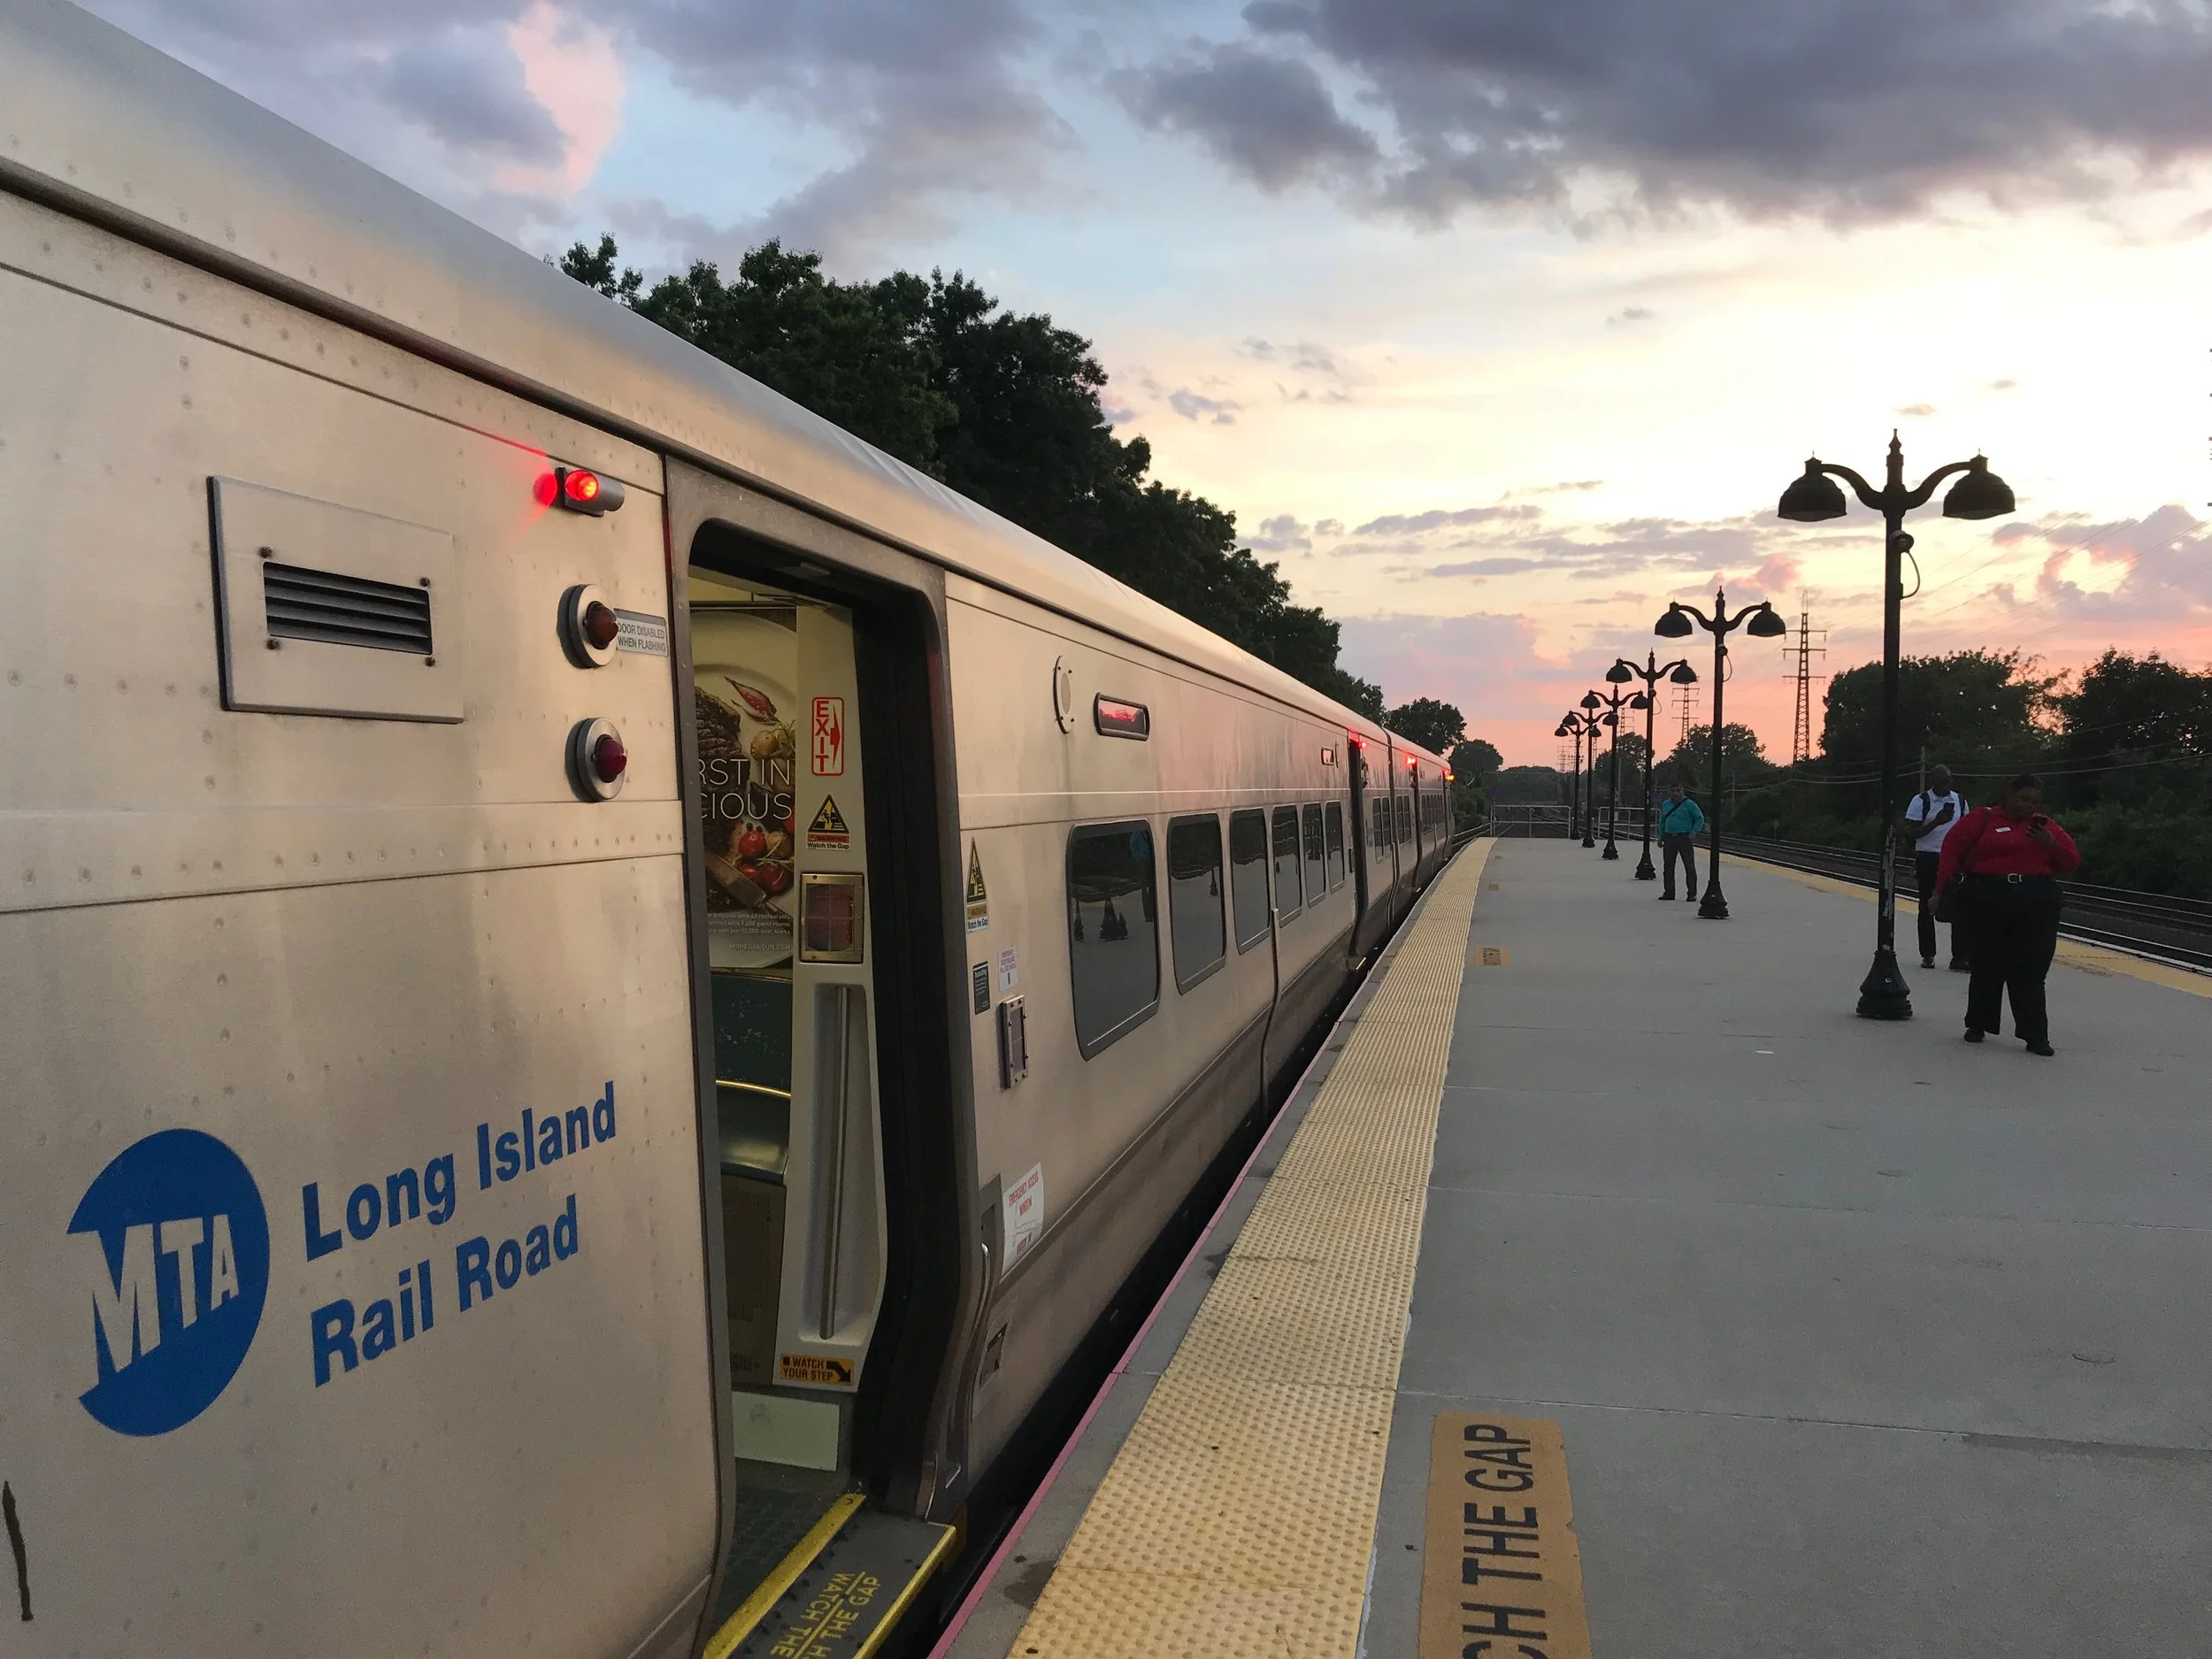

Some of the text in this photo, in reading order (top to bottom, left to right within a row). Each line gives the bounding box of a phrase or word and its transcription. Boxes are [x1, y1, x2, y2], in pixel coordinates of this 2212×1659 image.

[618, 622, 664, 639] DOOR DISABLED
[618, 635, 666, 652] WHEN FLASHING
[815, 701, 830, 772] EXIT
[762, 758, 790, 786] IN
[301, 1079, 617, 1263] Long Island
[71, 1212, 242, 1391] MTA
[310, 1193, 580, 1389] Rail Road
[783, 1367, 833, 1381] YOUR STEP
[792, 1356, 825, 1370] WATCH
[1463, 1423, 1534, 1493] GAP
[1462, 1502, 1542, 1585] THE
[769, 1573, 856, 1657] WATCH THE
[818, 1609, 860, 1640] THE
[848, 1576, 881, 1606] GAP
